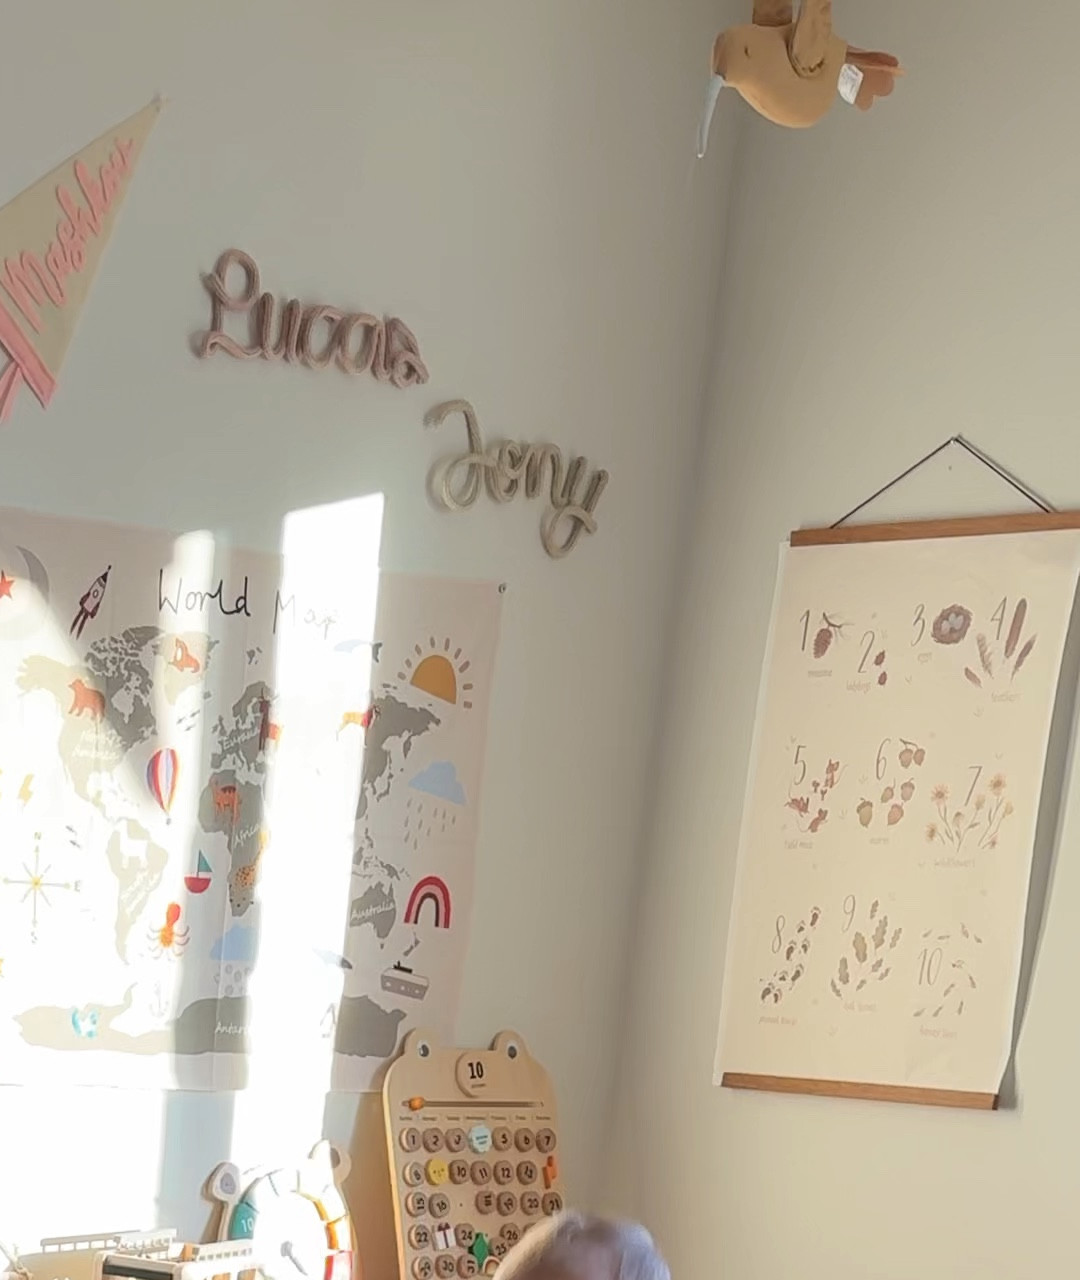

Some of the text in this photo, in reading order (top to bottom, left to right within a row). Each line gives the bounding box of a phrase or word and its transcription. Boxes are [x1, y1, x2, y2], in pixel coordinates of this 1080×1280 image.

[199, 247, 430, 389] Lucas
[159, 568, 251, 617] World
[991, 596, 1007, 641] 4
[800, 609, 810, 651] 1
[911, 603, 925, 647] 3
[858, 630, 875, 673] 2
[794, 744, 807, 785] 5
[876, 737, 891, 781] 6
[964, 765, 983, 807] 7
[234, 823, 261, 849] Africa
[351, 901, 396, 919] Australia
[842, 894, 856, 933] 9
[772, 914, 785, 954] 8
[917, 948, 943, 986] 10
[468, 1061, 484, 1079] 10
[411, 1135, 416, 1145] 1
[432, 1135, 439, 1146] 2
[454, 1135, 461, 1145] 3
[501, 1134, 508, 1144] 5
[524, 1134, 530, 1145] 6
[544, 1135, 551, 1146] 7
[457, 1166, 466, 1177] 10
[479, 1168, 488, 1179] 11
[501, 1167, 511, 1178] 12
[436, 1201, 447, 1212] 16
[527, 1198, 539, 1209] 20
[549, 1199, 560, 1211] 21
[241, 1217, 254, 1233] 10
[416, 1232, 428, 1243] 22
[461, 1230, 473, 1241] 24
[506, 1230, 518, 1241] 26
[496, 1244, 507, 1255] 25
[442, 1260, 454, 1272] 30
